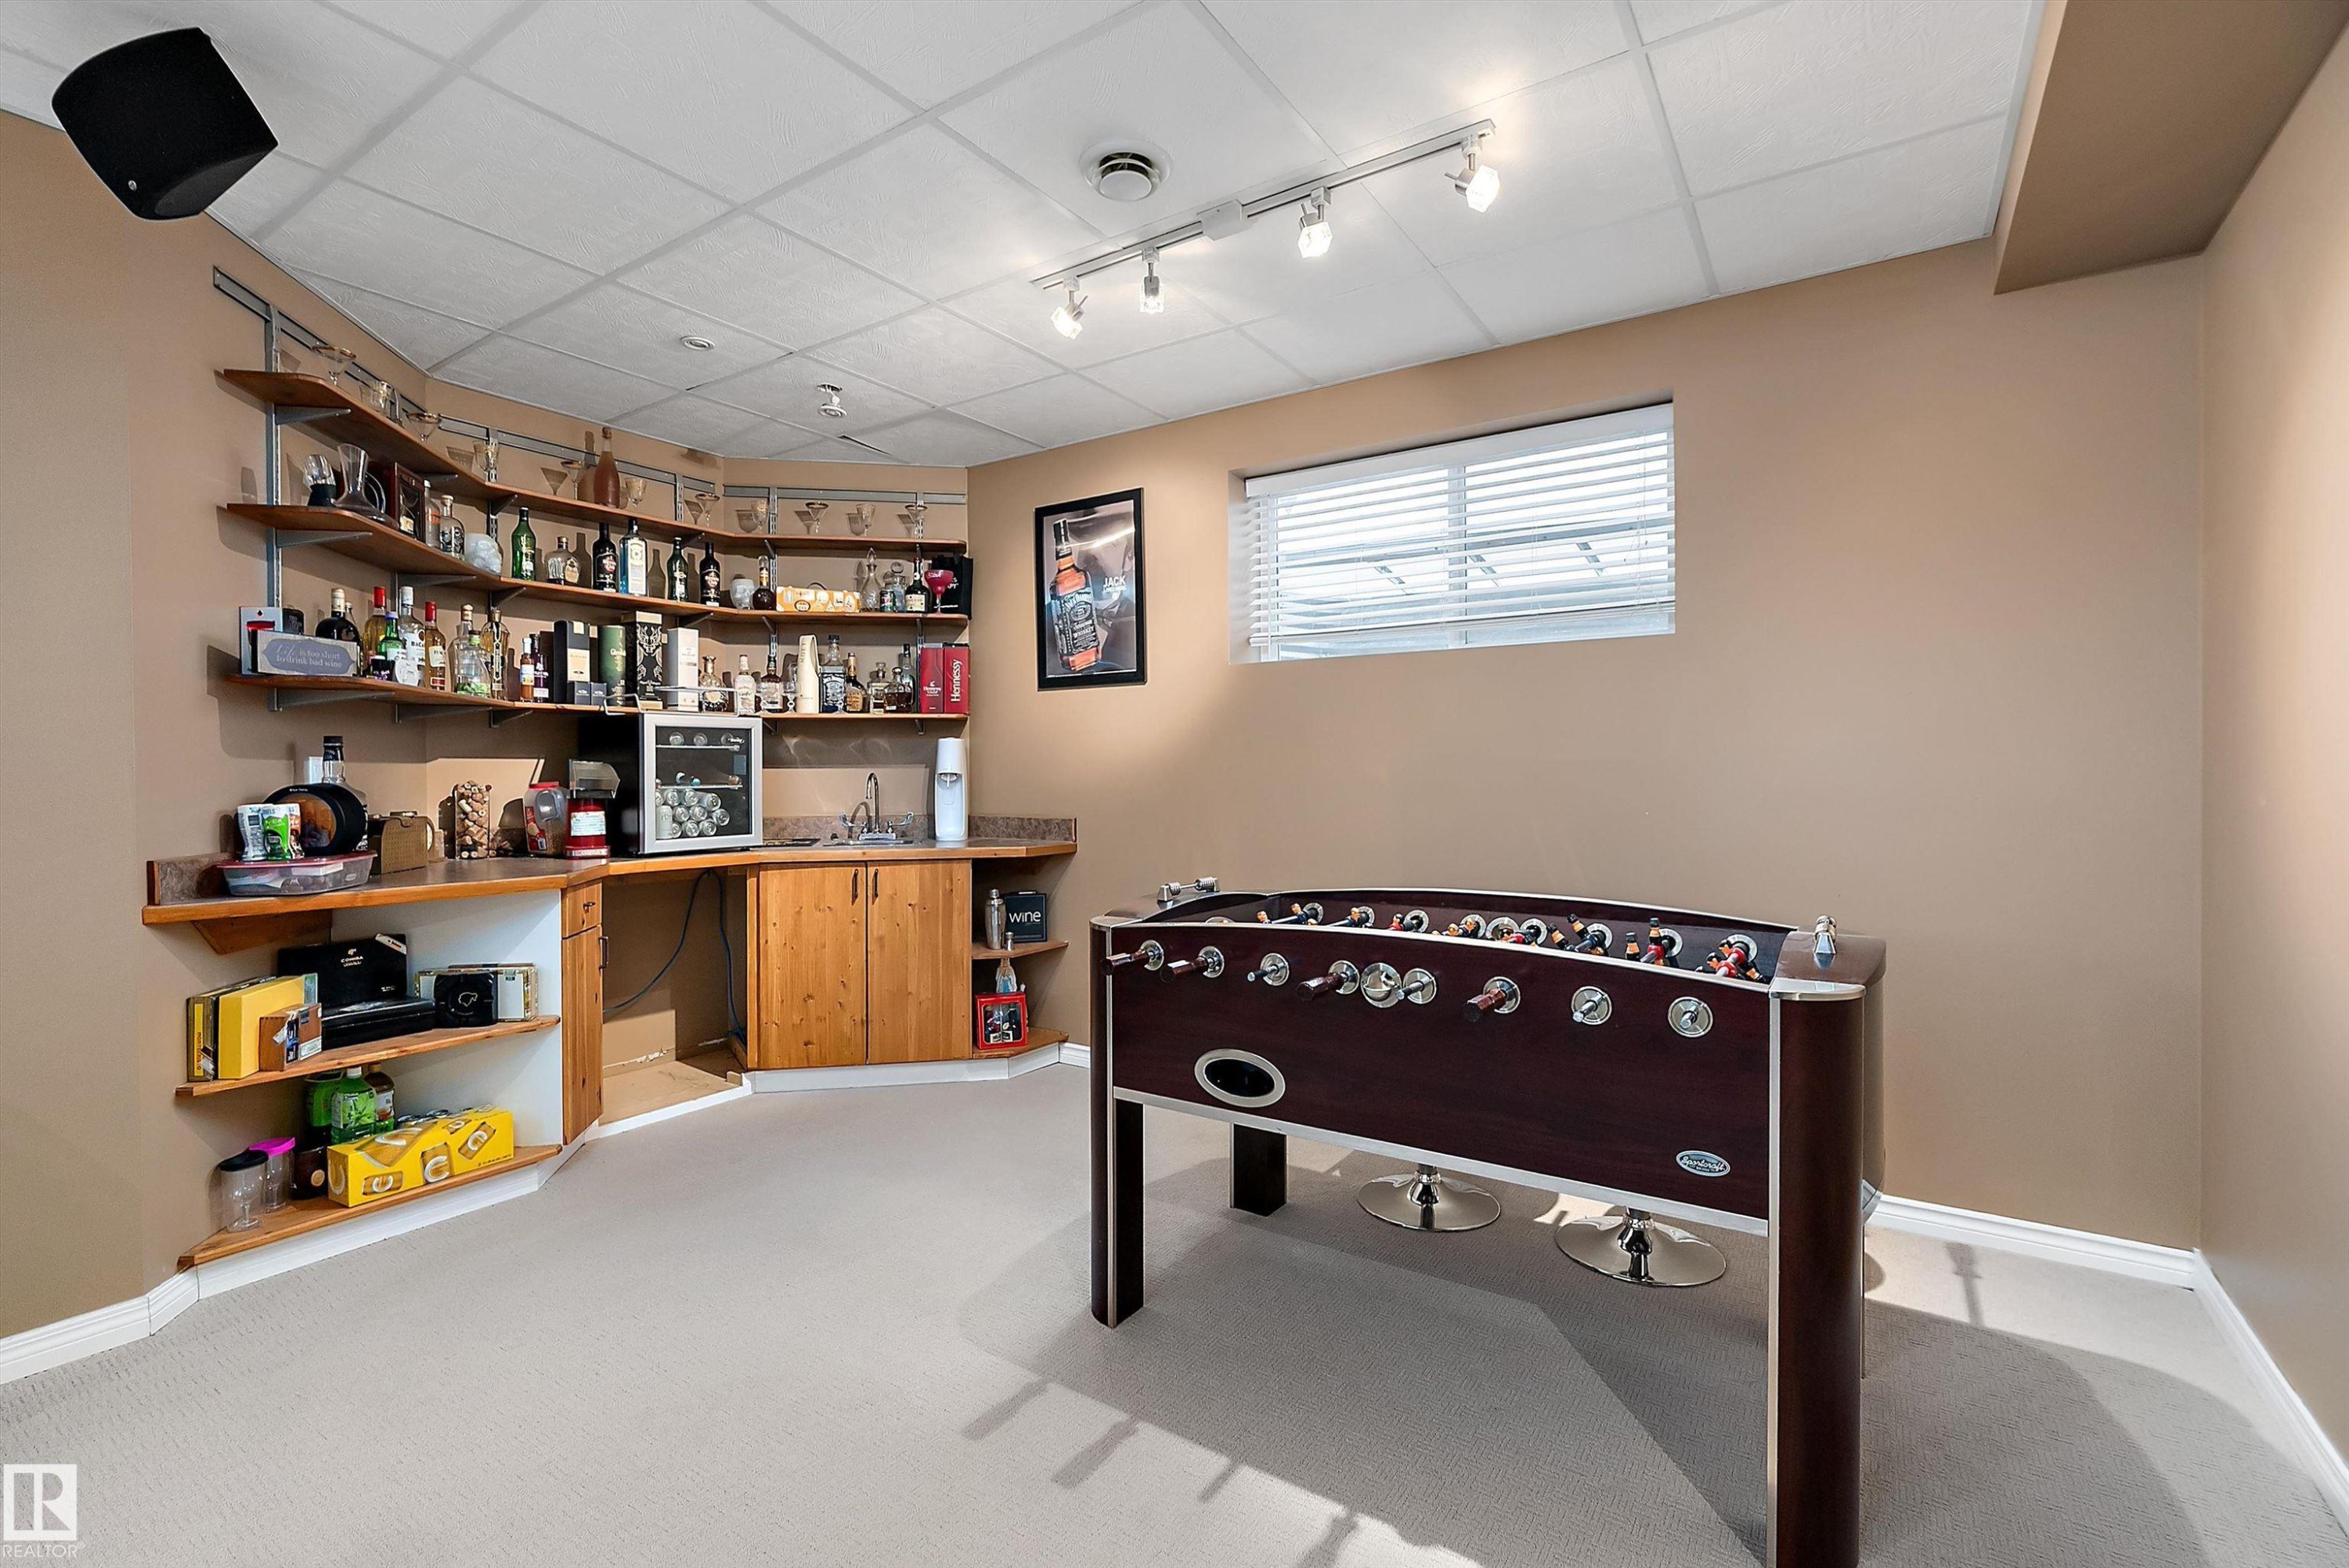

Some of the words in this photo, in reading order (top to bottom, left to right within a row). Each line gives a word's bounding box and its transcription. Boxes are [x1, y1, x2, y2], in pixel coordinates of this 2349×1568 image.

[1103, 575, 1126, 587] JACK
[286, 656, 308, 665] drink
[309, 658, 323, 666] bad
[321, 651, 340, 659] short
[951, 659, 962, 701] Hennessy
[1009, 911, 1041, 923] wine
[1681, 1156, 1726, 1172] Sportcraft
